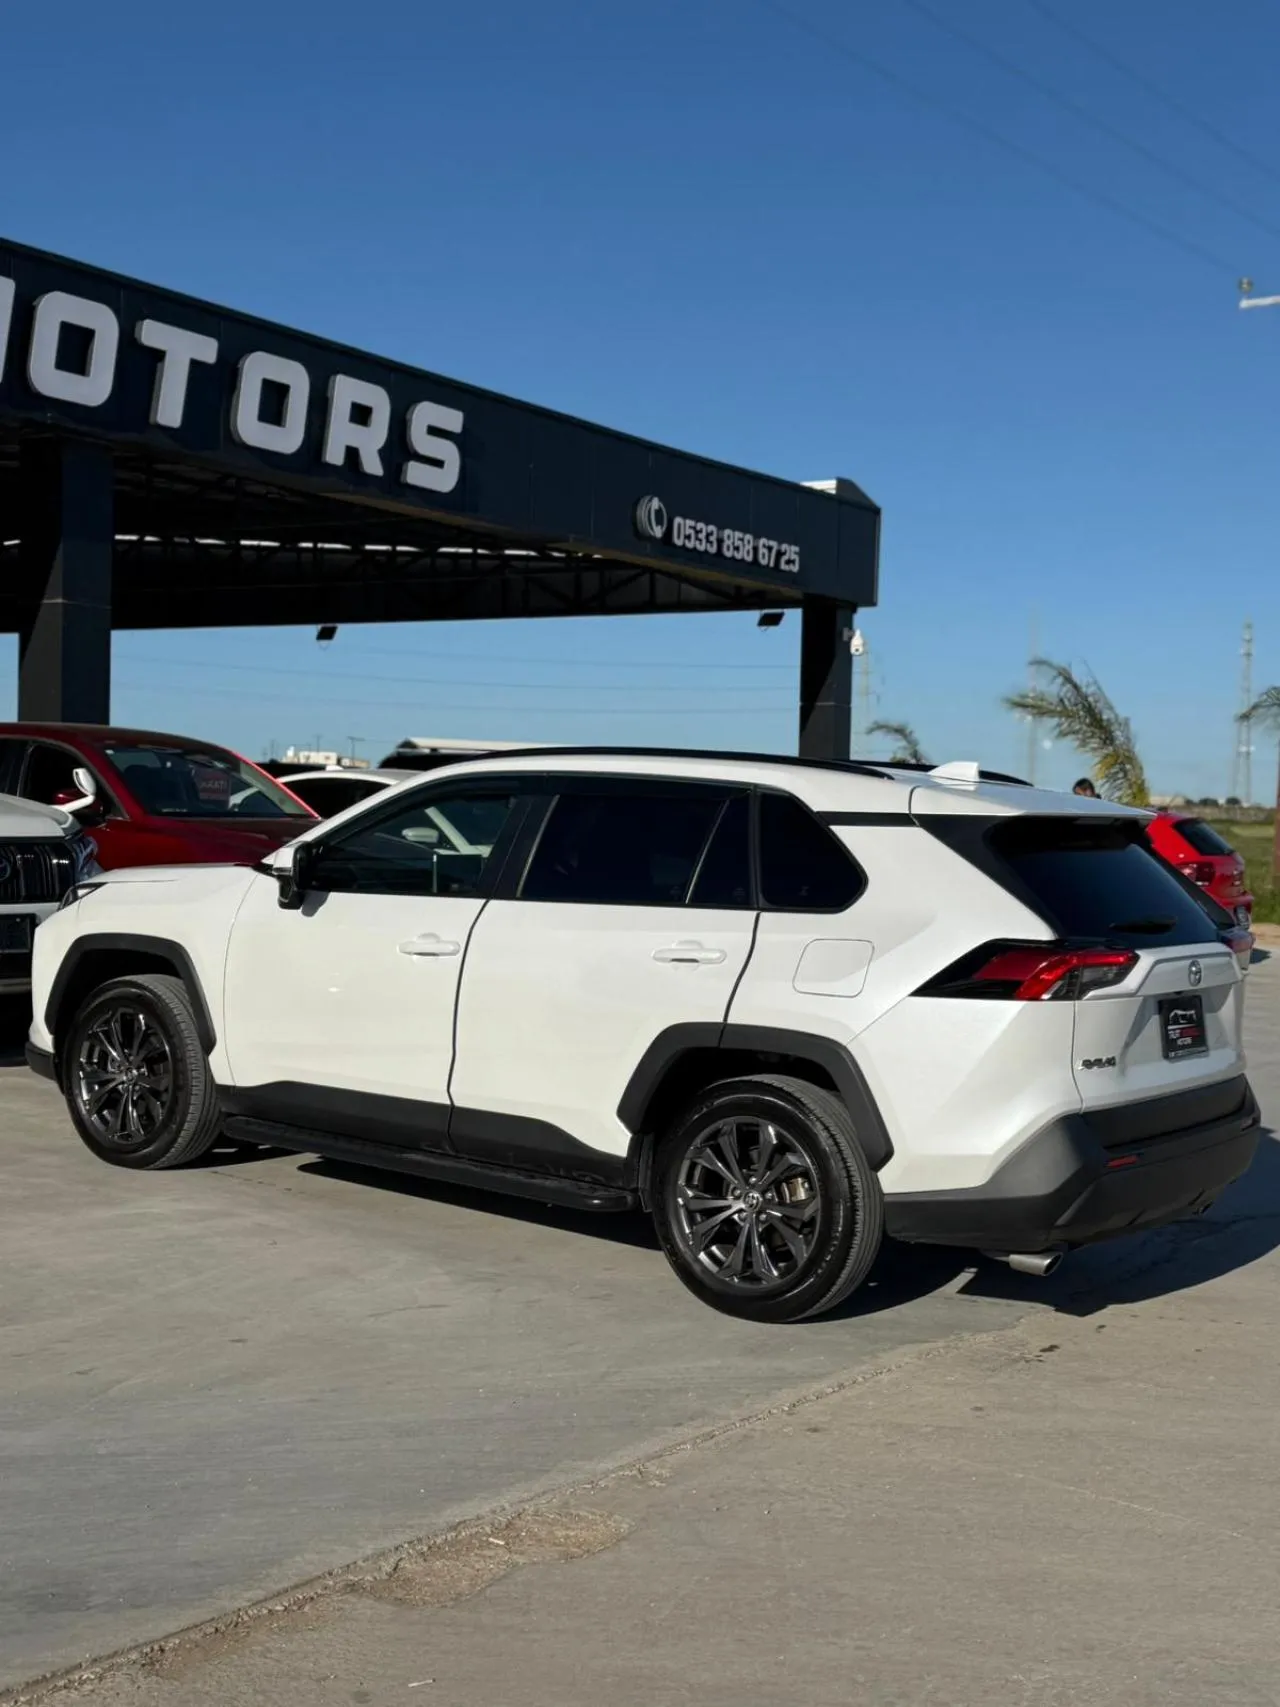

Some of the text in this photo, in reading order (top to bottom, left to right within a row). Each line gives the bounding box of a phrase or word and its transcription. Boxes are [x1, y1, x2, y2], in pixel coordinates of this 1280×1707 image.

[673, 516, 799, 573] 0533 858 67 25
